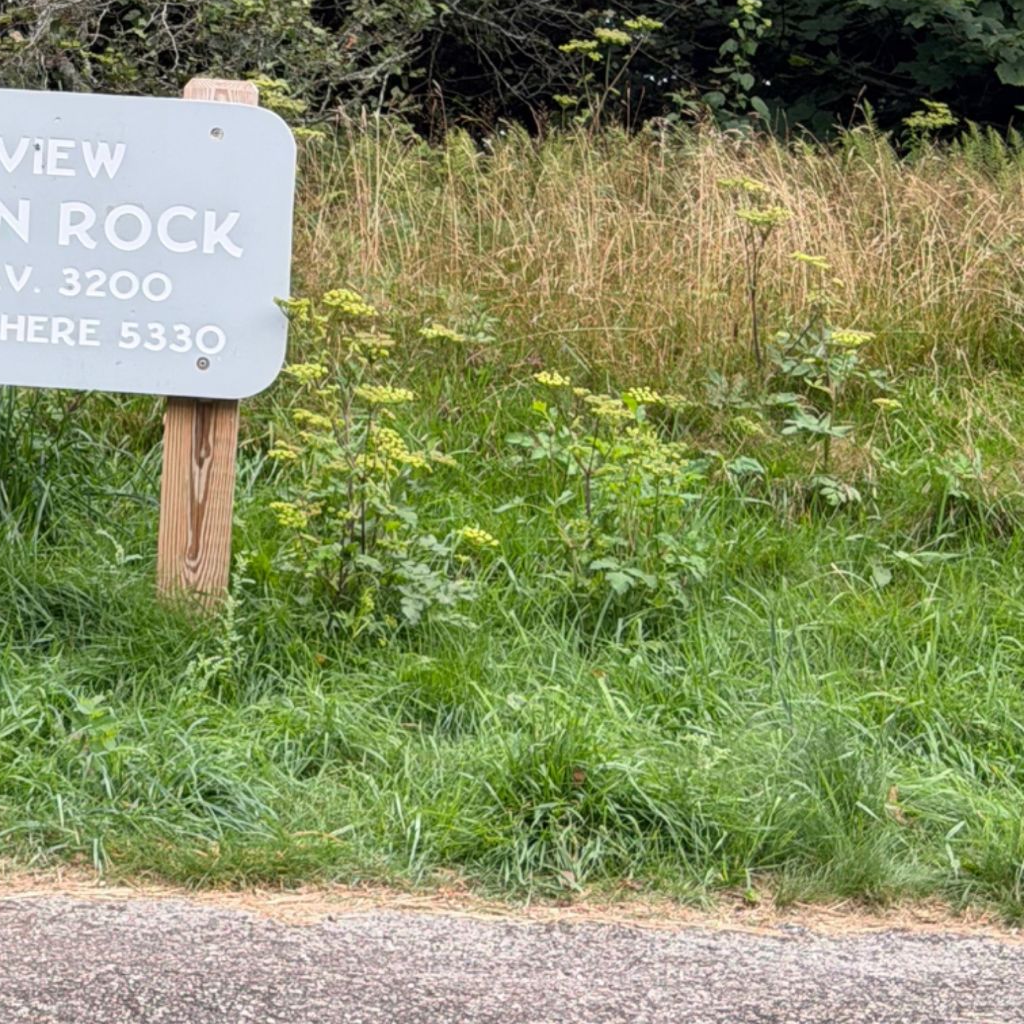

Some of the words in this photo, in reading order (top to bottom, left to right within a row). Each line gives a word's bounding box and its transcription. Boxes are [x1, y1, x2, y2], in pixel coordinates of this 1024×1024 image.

[58, 201, 244, 258] ROCK
[58, 267, 173, 302] 3200
[0, 314, 101, 347] HERE
[118, 322, 227, 355] 5330
